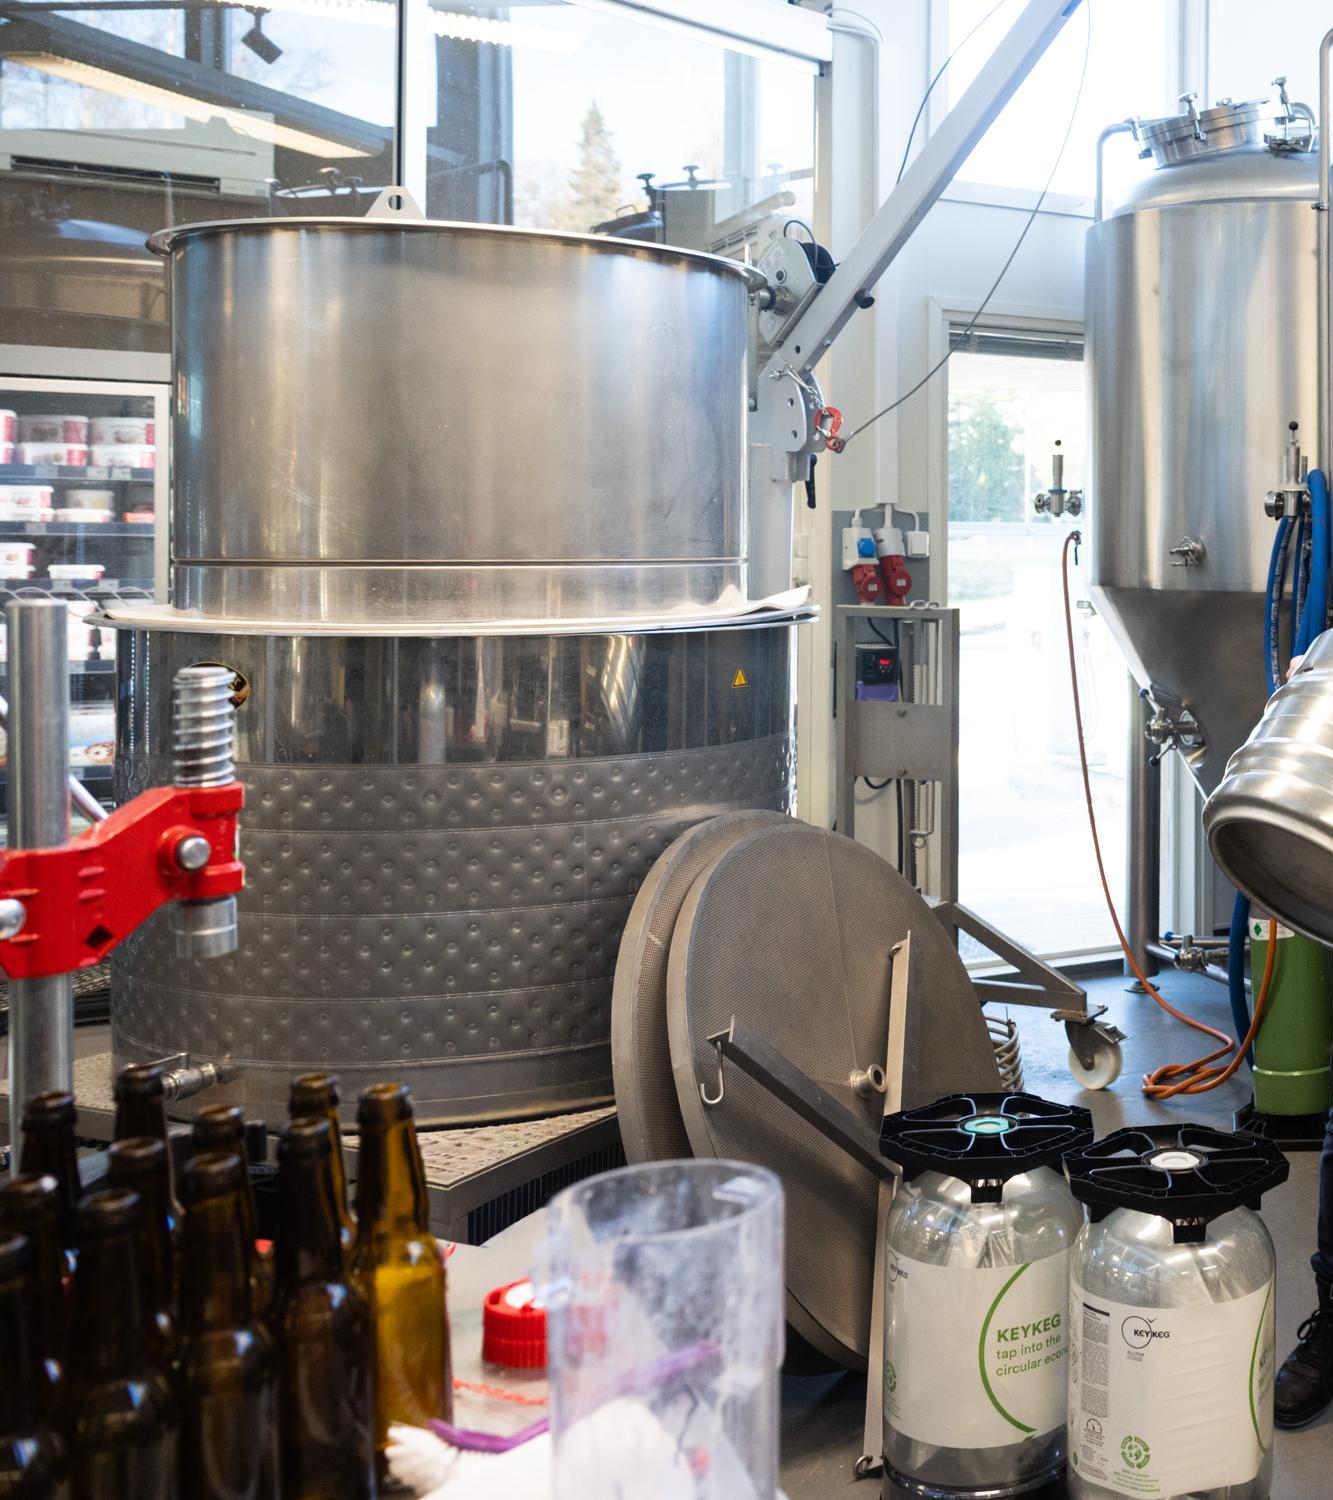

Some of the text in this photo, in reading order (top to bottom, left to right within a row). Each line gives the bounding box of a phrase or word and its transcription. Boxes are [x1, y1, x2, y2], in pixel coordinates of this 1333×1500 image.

[997, 1314, 1061, 1343] KEYKEG
[1133, 1328, 1170, 1339] KEYKEG
[996, 1334, 1062, 1361] tap into the
[996, 1358, 1042, 1376] circular
